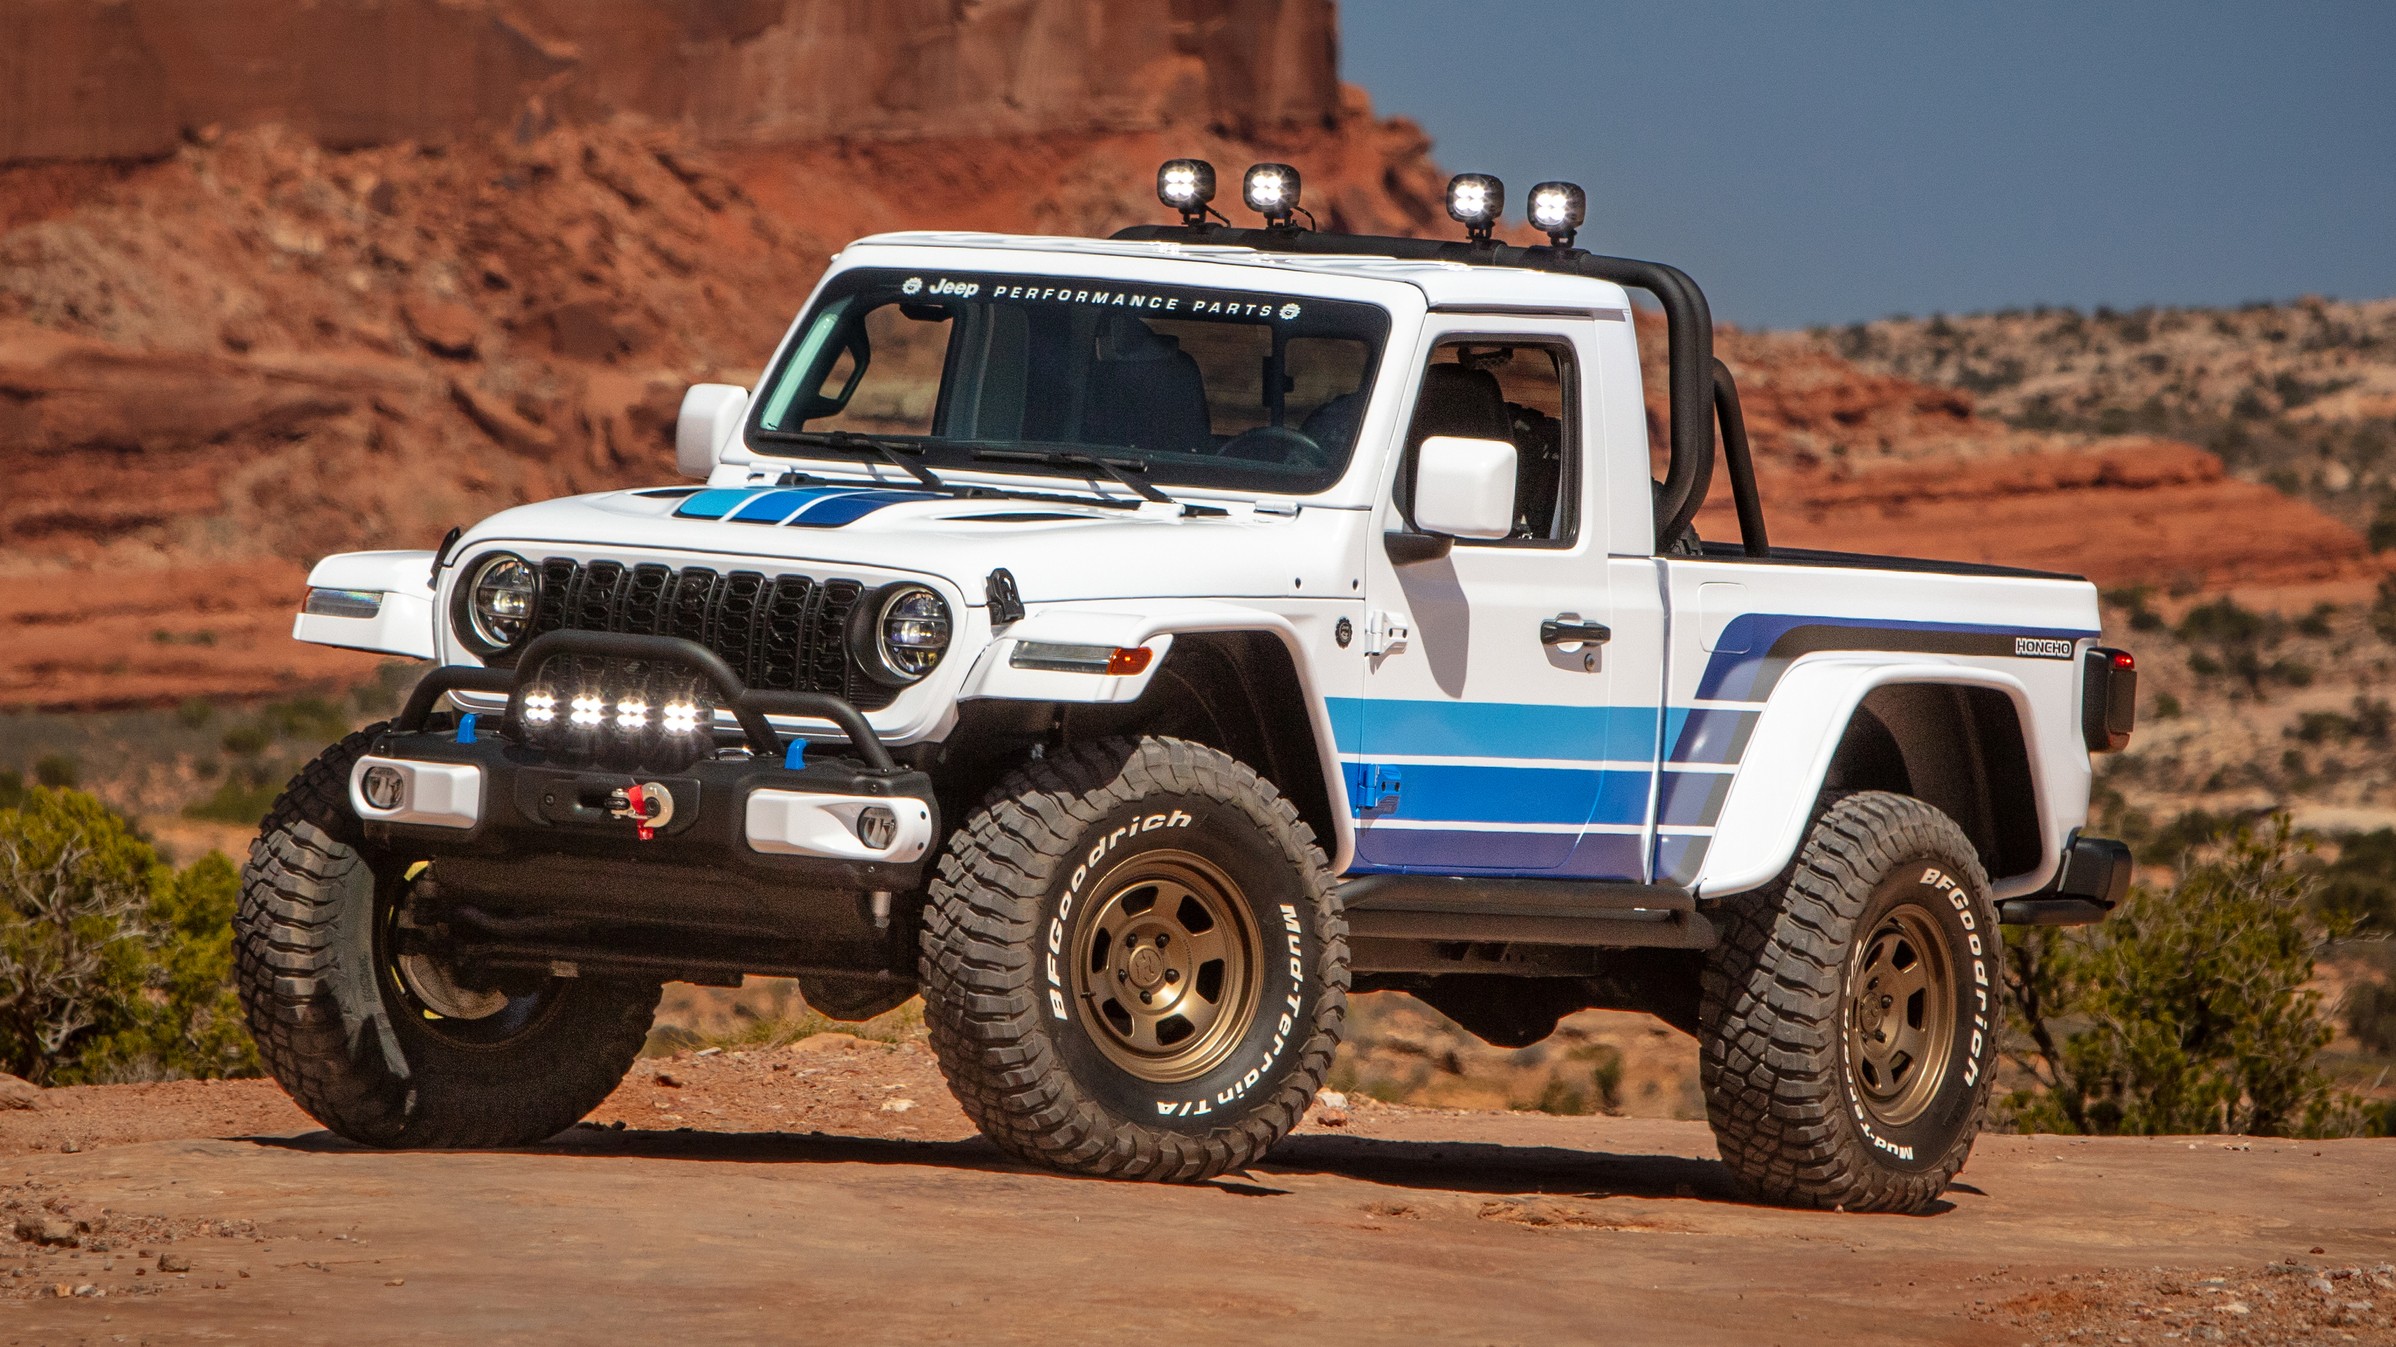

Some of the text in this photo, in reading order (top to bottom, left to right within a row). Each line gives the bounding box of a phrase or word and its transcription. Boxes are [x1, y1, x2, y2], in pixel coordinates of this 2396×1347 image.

[929, 278, 1272, 317] Jeep PERFORMANCE PARTS
[2016, 639, 2071, 656] HONCHO
[1047, 810, 1192, 1020] BFGoodrich
[1157, 904, 1302, 1118] Mud-Terrain T/A
[1919, 868, 1988, 1088] BFGoodrich
